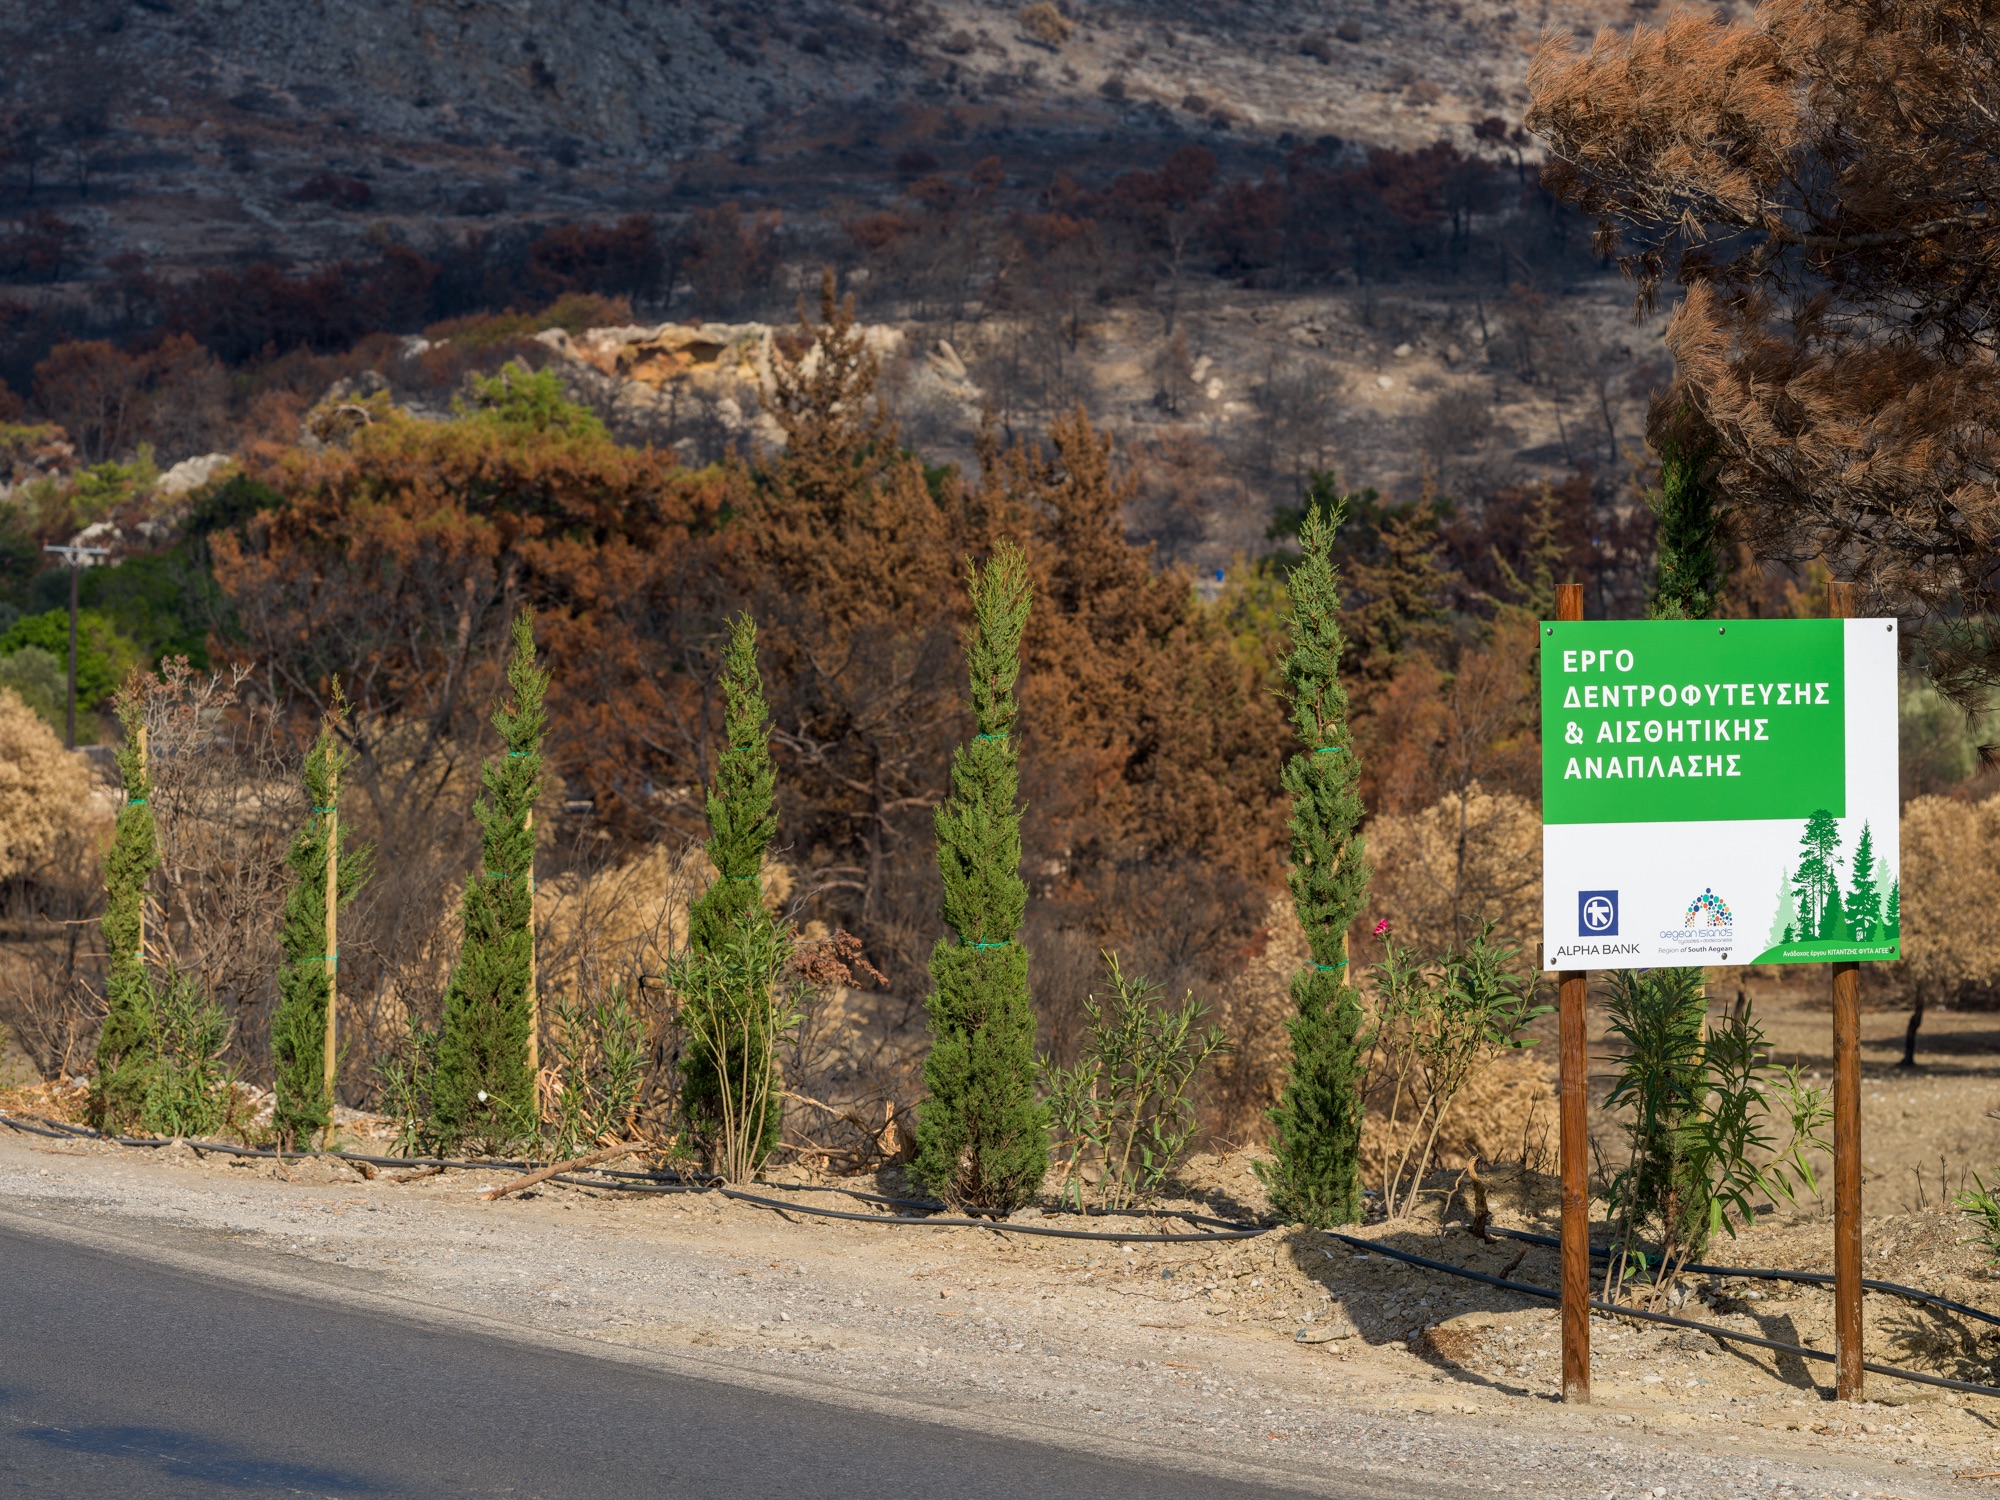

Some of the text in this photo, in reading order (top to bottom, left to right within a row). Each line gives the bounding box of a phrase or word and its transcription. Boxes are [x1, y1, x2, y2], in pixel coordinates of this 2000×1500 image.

[1563, 650, 1634, 672] ΕΡΓΟ
[1563, 683, 1830, 708] ΔΕΝΤΡΟΦΥΤΕΥΣΗΣ
[1565, 719, 1769, 744] & ΑΙΣΘΗΤΙΚΗΣ
[1563, 755, 1741, 780] ΑΝΑΠΛΑΣΗΣ
[1660, 929, 1697, 941] aegean
[1557, 943, 1640, 956] ALPHA BANK
